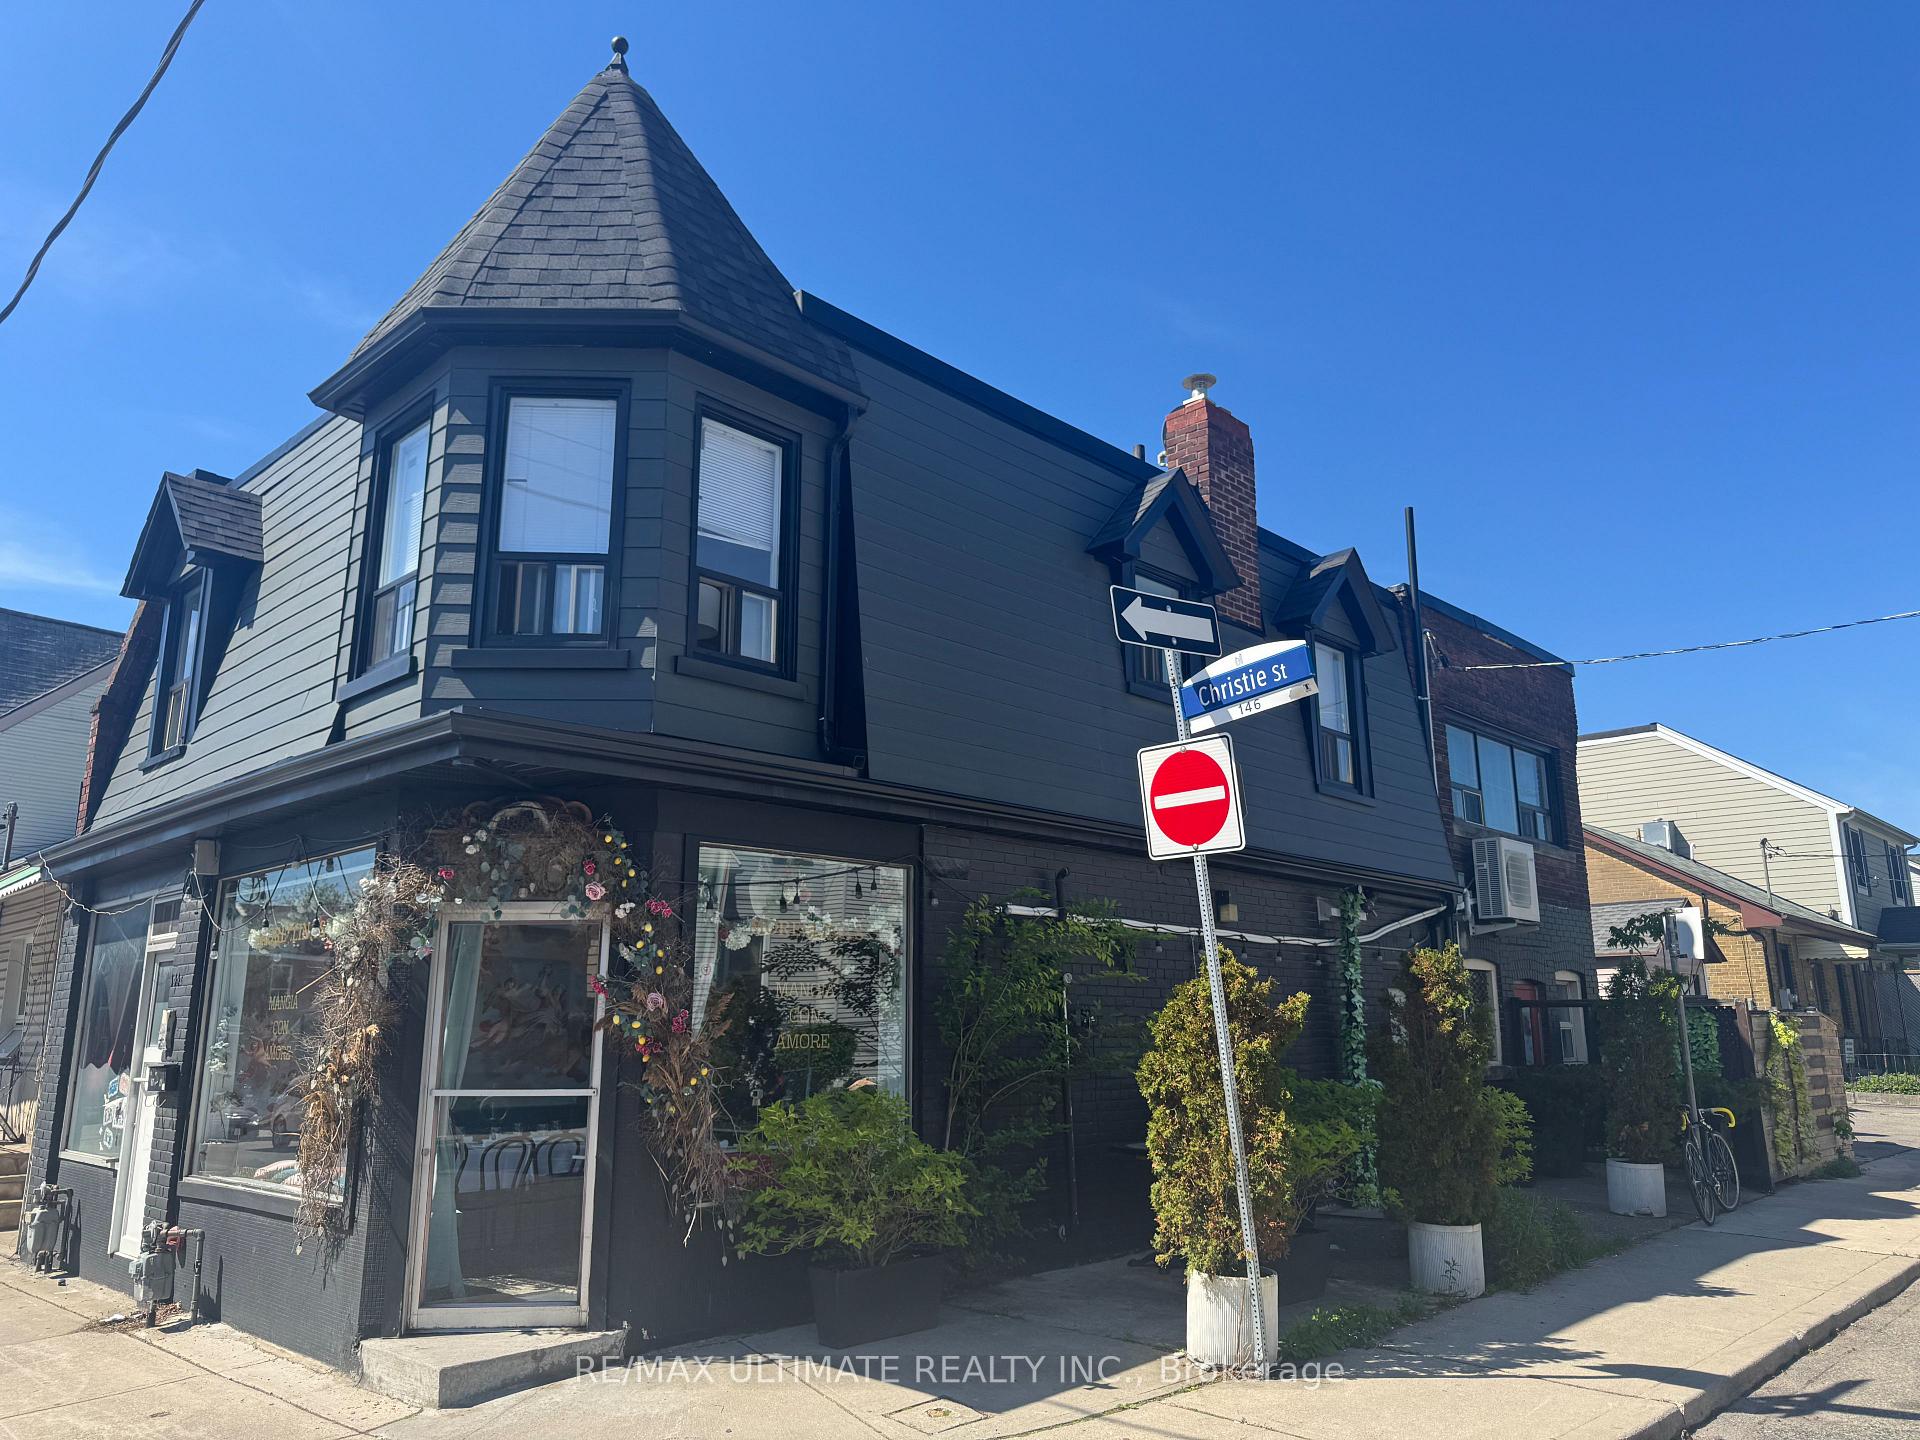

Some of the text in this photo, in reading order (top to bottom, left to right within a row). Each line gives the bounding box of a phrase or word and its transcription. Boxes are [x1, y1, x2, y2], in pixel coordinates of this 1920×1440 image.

[1198, 663, 1288, 707] Christie St
[1238, 699, 1261, 715] 146
[268, 992, 299, 1011] MANGIA
[272, 1020, 290, 1035] CON
[775, 1033, 831, 1049] AMORE
